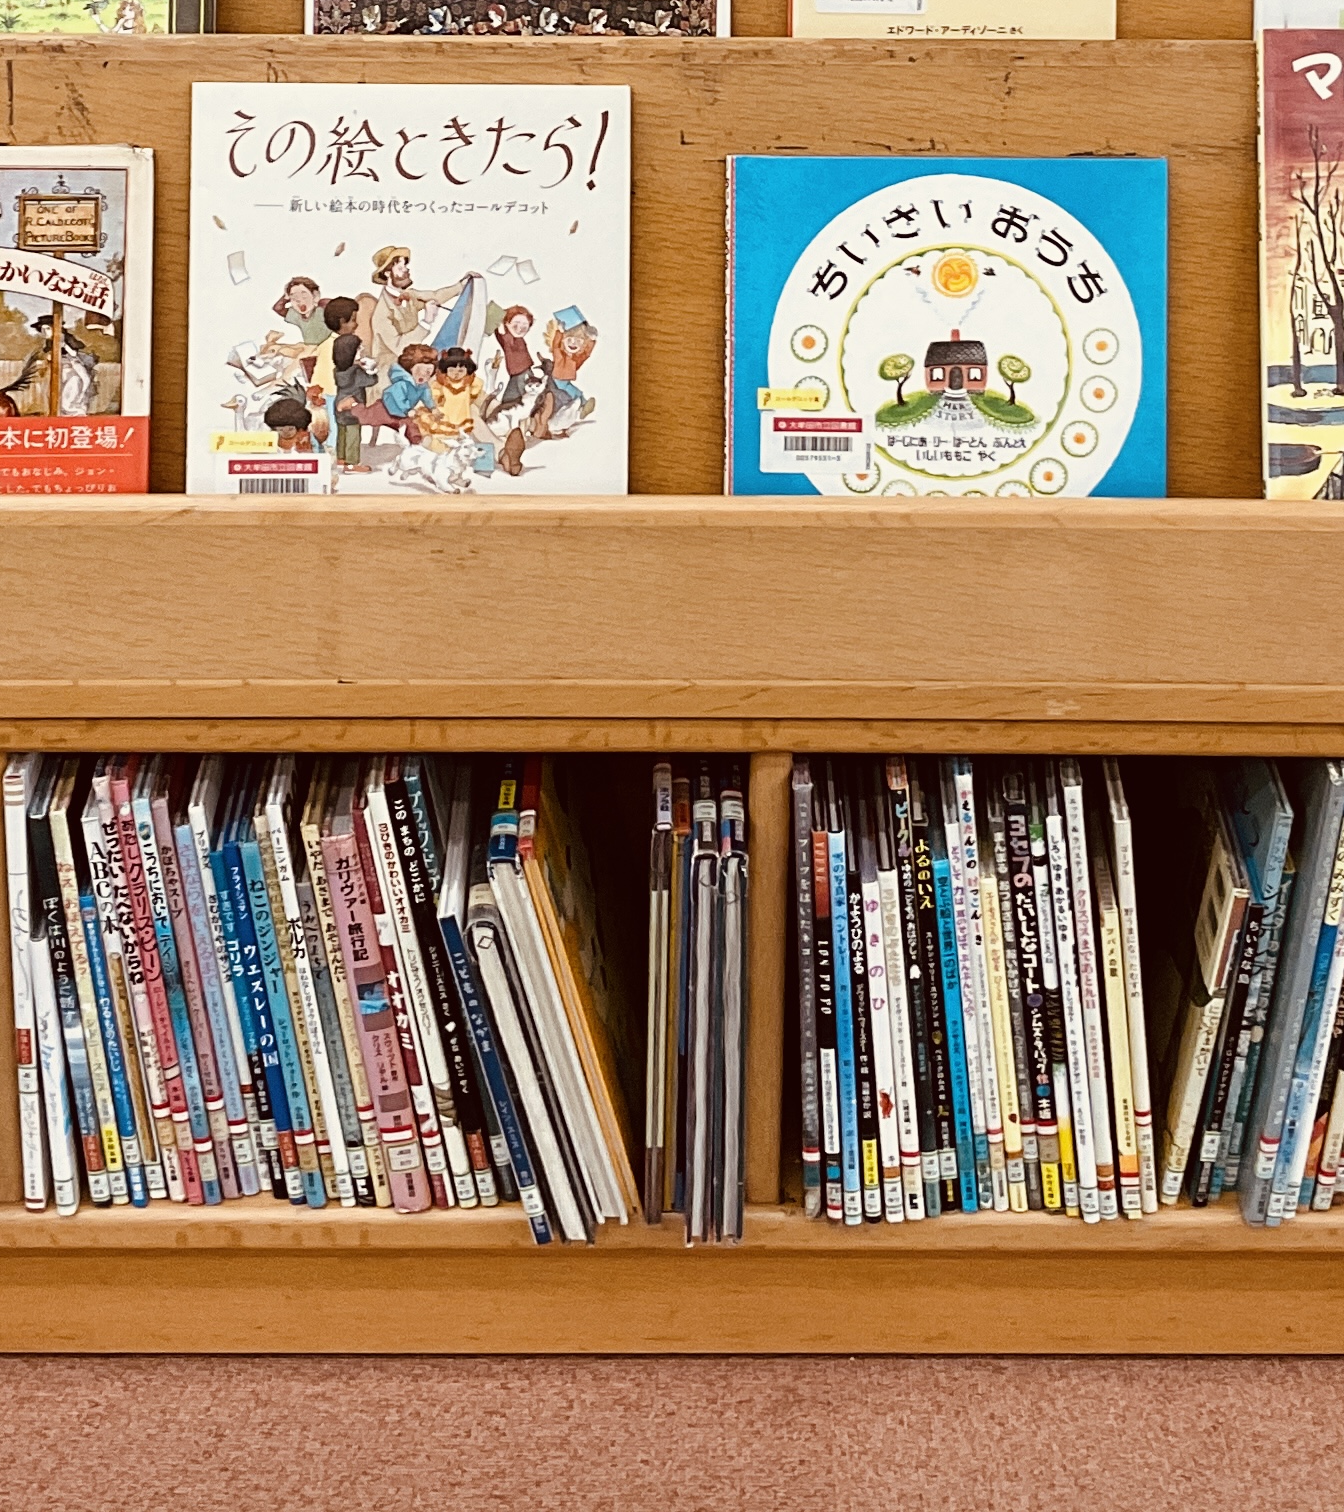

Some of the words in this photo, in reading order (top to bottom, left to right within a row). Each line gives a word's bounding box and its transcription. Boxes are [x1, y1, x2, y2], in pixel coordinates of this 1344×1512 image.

[224, 109, 611, 192] その絵ときたら!
[36, 204, 60, 215] ONE
[915, 450, 972, 462] いしいももこ
[977, 450, 997, 462] やく
[102, 817, 126, 879] ぜったい
[914, 838, 935, 910] よるのいえ
[1007, 814, 1033, 888] ヨセフの
[90, 841, 120, 934] ABCの本
[335, 857, 370, 963] ガリヴァー旅行記
[113, 885, 145, 985] たべないからね
[227, 940, 245, 977] ゴリラ
[249, 879, 281, 994] ねこのジンジャー
[288, 918, 306, 960] ボルカ
[863, 896, 886, 1011] ゆきのひ
[1015, 890, 1041, 994] だいじなコート
